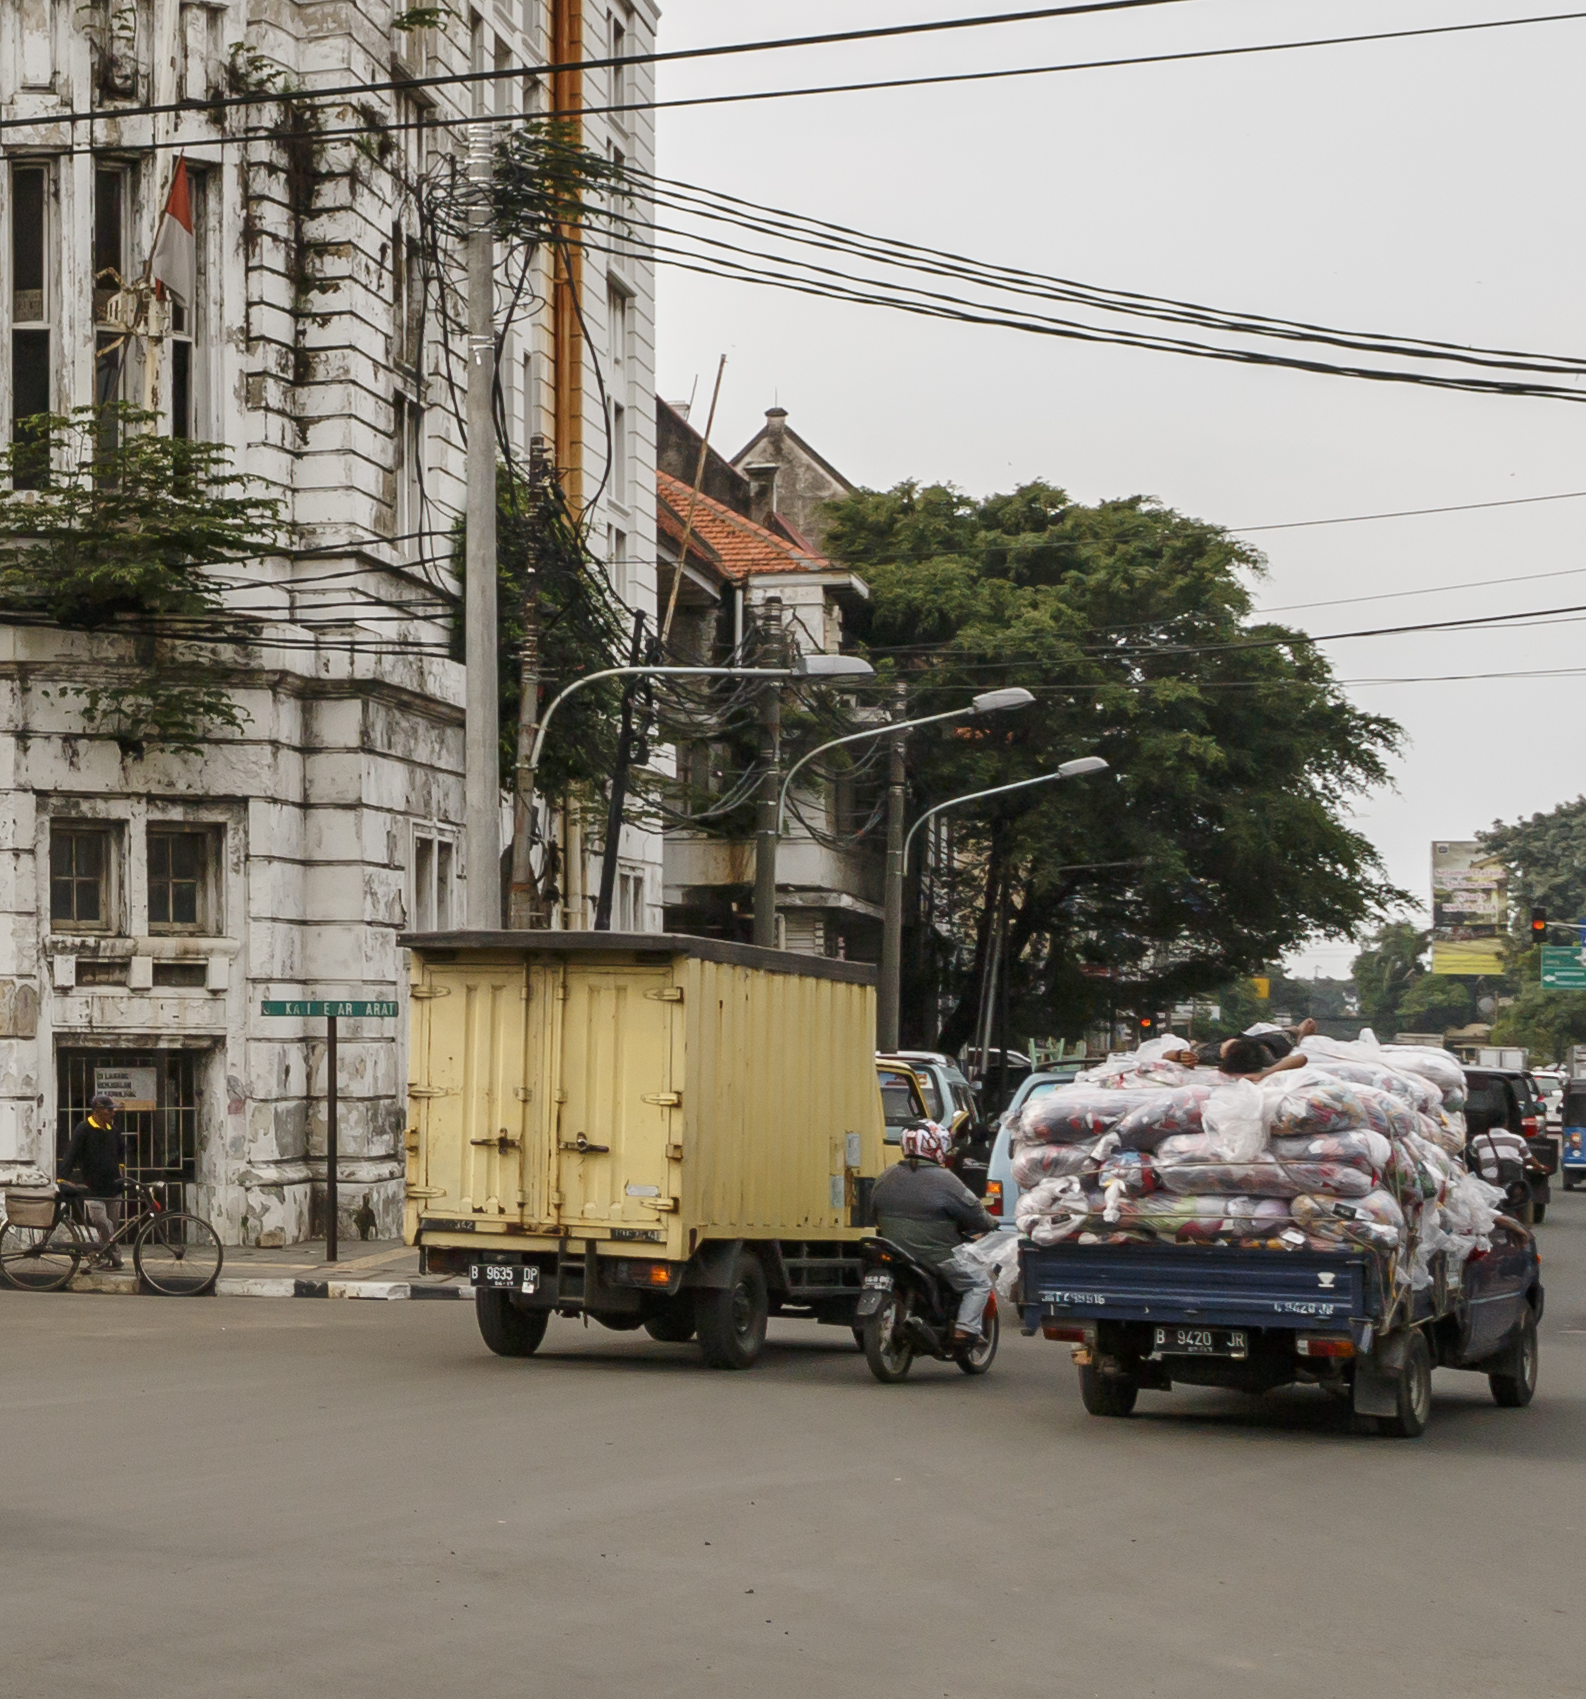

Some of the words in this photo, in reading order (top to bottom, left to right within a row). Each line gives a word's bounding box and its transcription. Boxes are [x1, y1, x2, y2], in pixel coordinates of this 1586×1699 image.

[285, 1002, 311, 1015] KAI
[365, 1002, 394, 1015] ARAT
[471, 1265, 479, 1280] B
[486, 1266, 514, 1280] 9635
[523, 1267, 538, 1281] DP
[1156, 1328, 1165, 1344] B
[1177, 1330, 1212, 1346] 9420
[1227, 1332, 1244, 1347] JR
